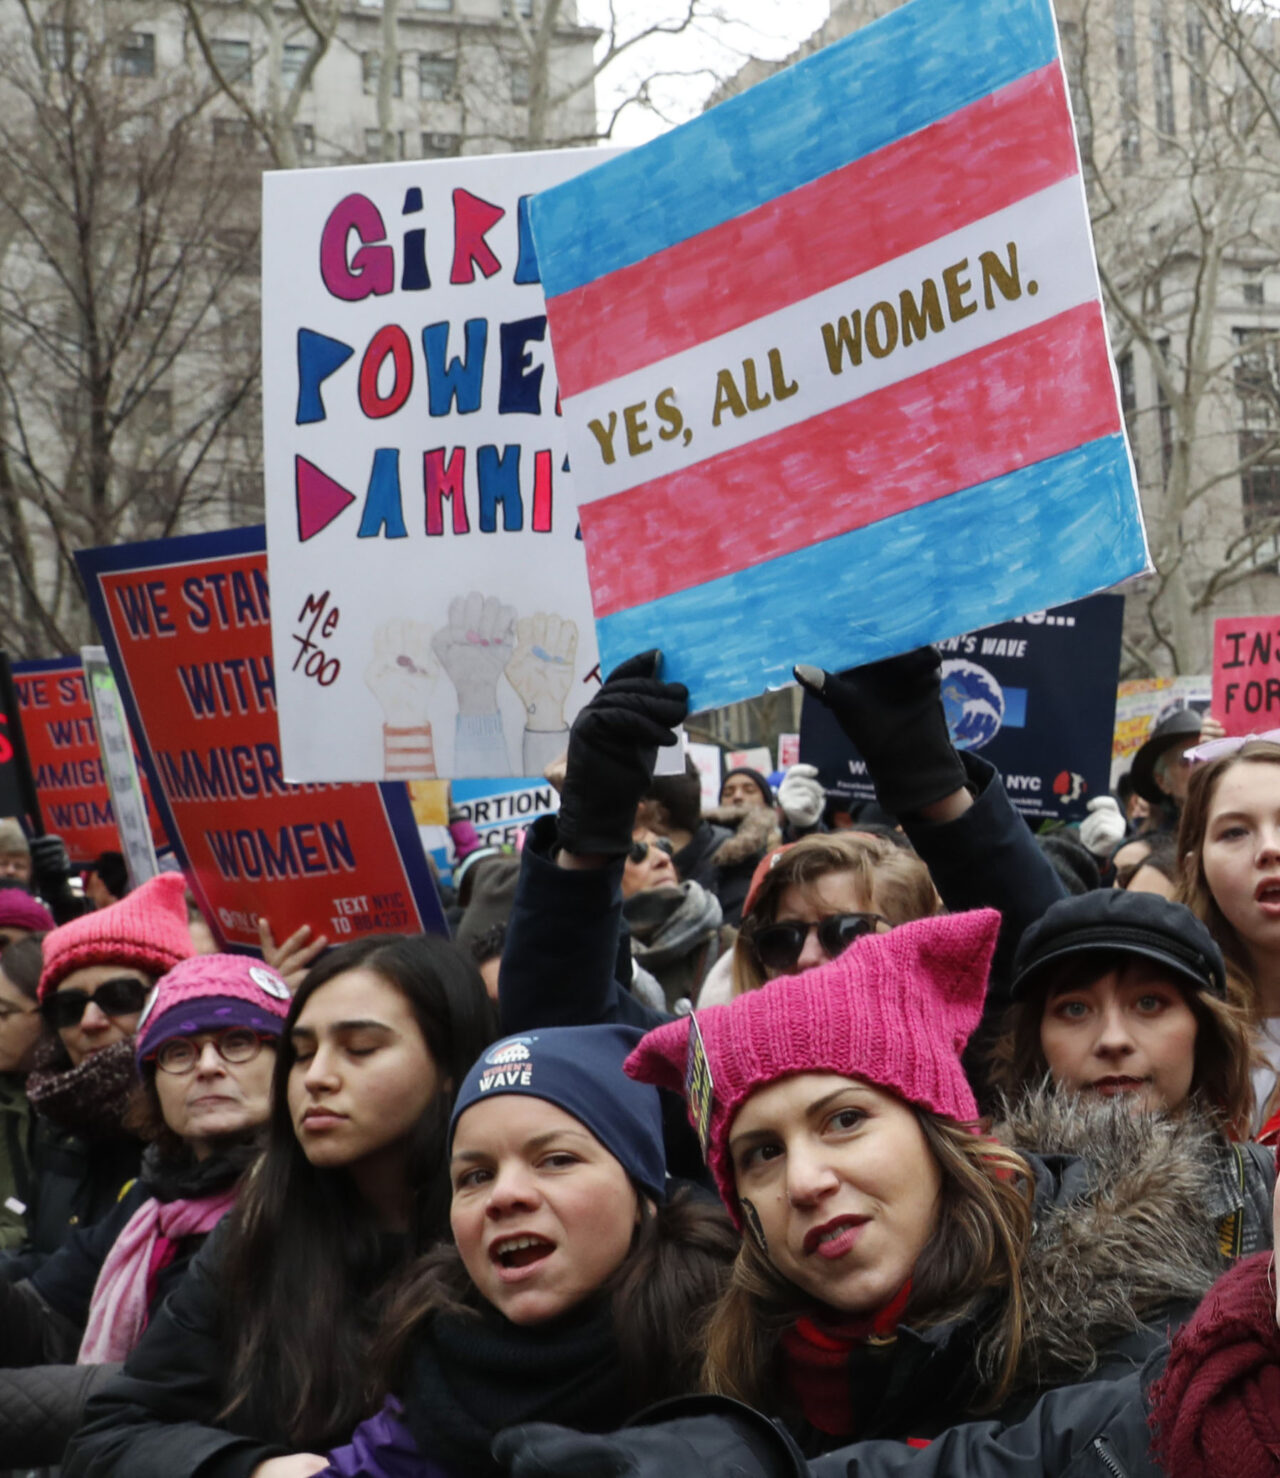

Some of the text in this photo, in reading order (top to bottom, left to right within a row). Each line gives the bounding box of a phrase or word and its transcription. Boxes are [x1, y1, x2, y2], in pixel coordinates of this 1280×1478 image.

[295, 318, 561, 425] POWE
[587, 242, 1039, 466] YES, ALL WOMEN.
[295, 444, 583, 543] DAMMI
[115, 568, 271, 640] WE STAN
[299, 590, 339, 638] Me
[981, 637, 1028, 658] WAVE
[46, 719, 97, 749] WIT
[1006, 774, 1042, 791] NYC
[204, 820, 356, 883] WOMEN
[330, 917, 351, 934] TO
[333, 896, 369, 916] TEXT
[479, 1071, 533, 1092] WAVE
